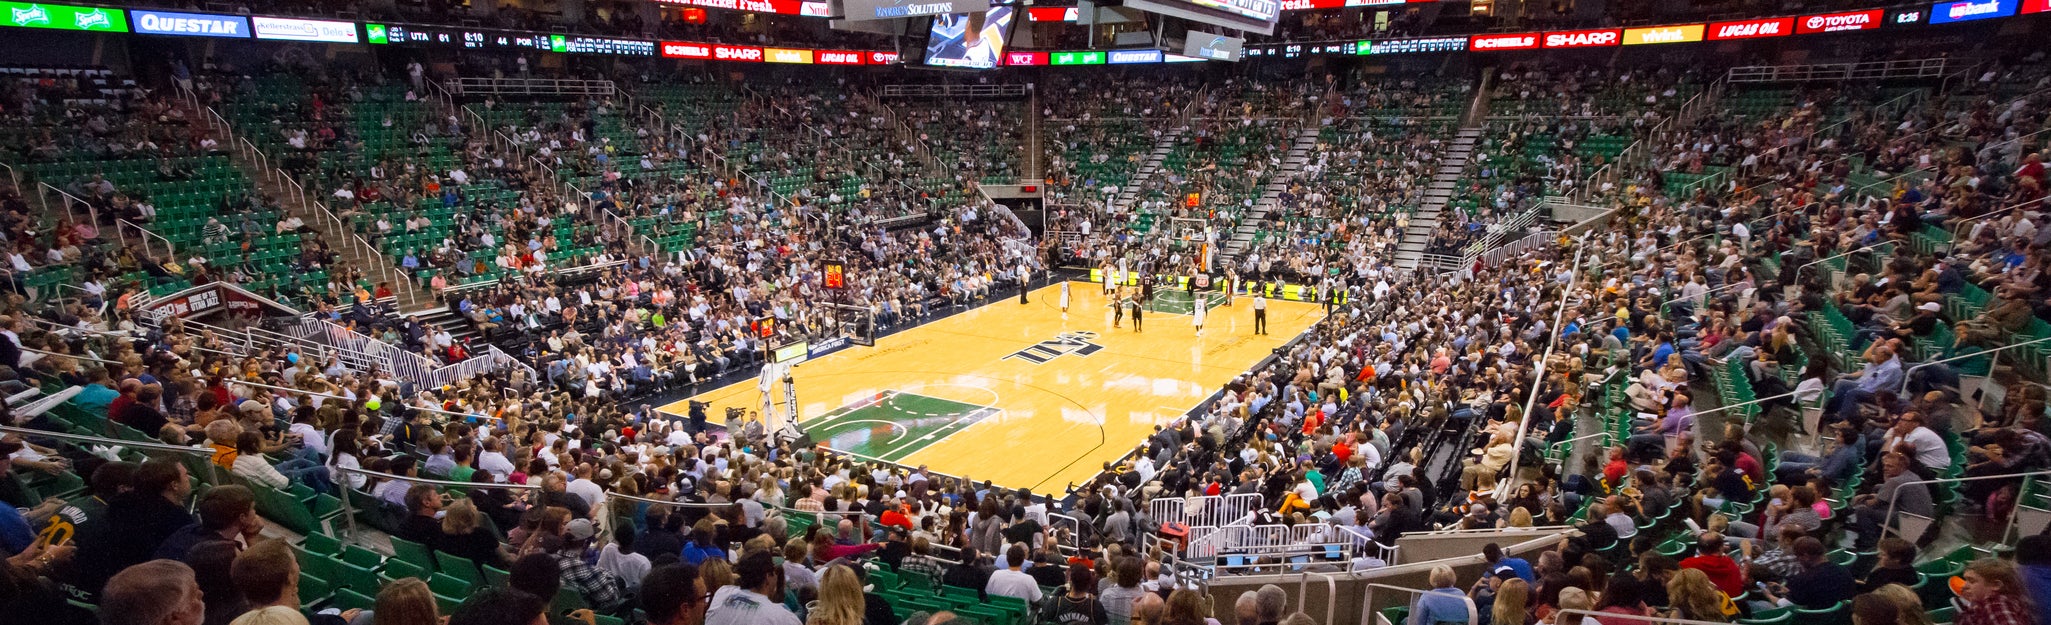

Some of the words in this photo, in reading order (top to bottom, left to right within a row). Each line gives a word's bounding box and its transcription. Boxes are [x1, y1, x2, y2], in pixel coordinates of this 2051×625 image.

[740, 0, 777, 13] Fresh.
[1281, 0, 1315, 10] resh.
[141, 13, 238, 34] QUESTAR
[1825, 14, 1869, 26] TOYOTA
[1718, 24, 1758, 37] LUCAS
[1759, 21, 1780, 34] OIL
[410, 32, 429, 41] UTA
[438, 34, 449, 42] 61
[464, 32, 484, 42] 6:10
[497, 37, 507, 45] 44
[516, 38, 532, 46] POR
[664, 45, 709, 56] SCHEELS
[821, 53, 845, 63] LUCAS
[1012, 55, 1033, 64] WCF
[1113, 52, 1158, 62] QUESTAR
